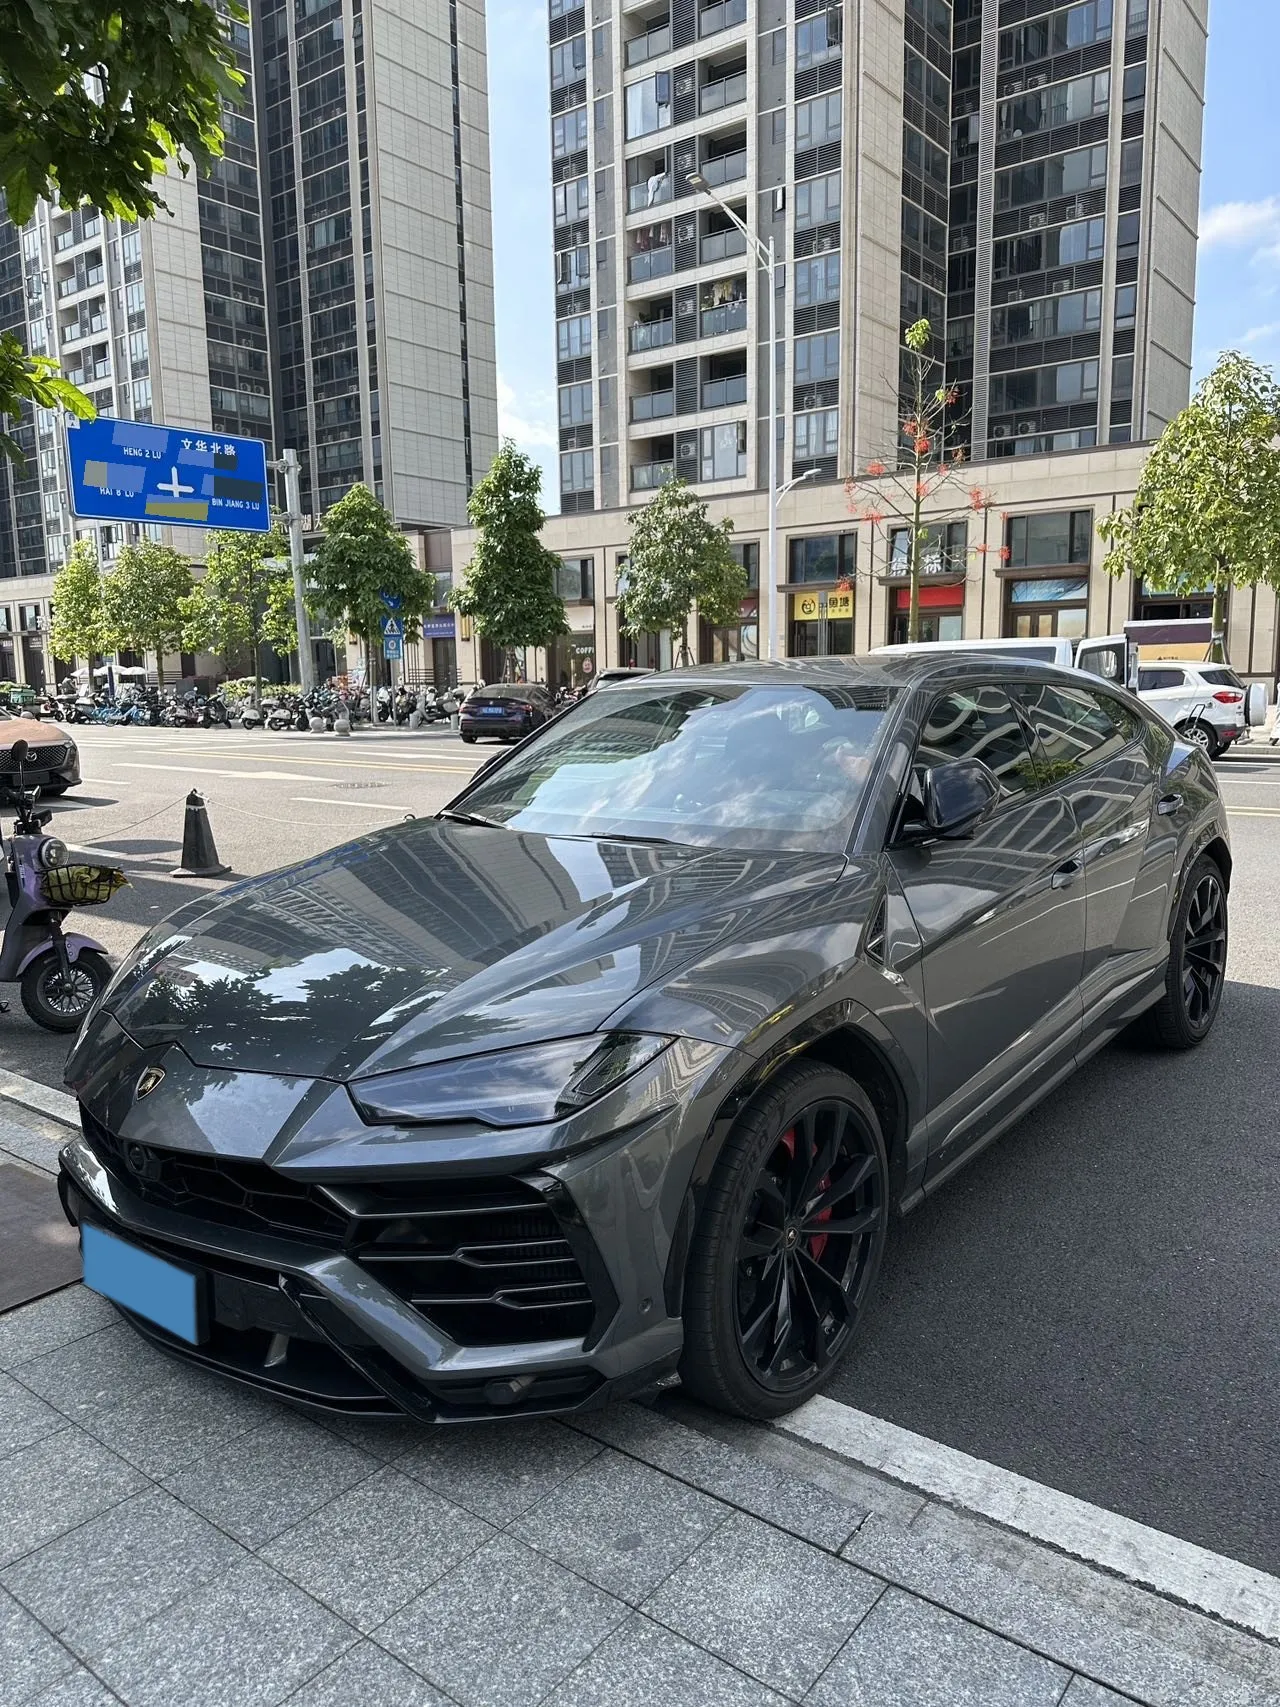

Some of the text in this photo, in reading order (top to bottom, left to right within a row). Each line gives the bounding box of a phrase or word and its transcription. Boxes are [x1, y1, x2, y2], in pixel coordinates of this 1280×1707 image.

[123, 447, 161, 459] HENG 2 LU
[181, 438, 236, 456] 文华北路
[100, 487, 113, 496] HAI
[125, 490, 134, 498] LU
[211, 498, 260, 510] BIN JIANG 3 LU
